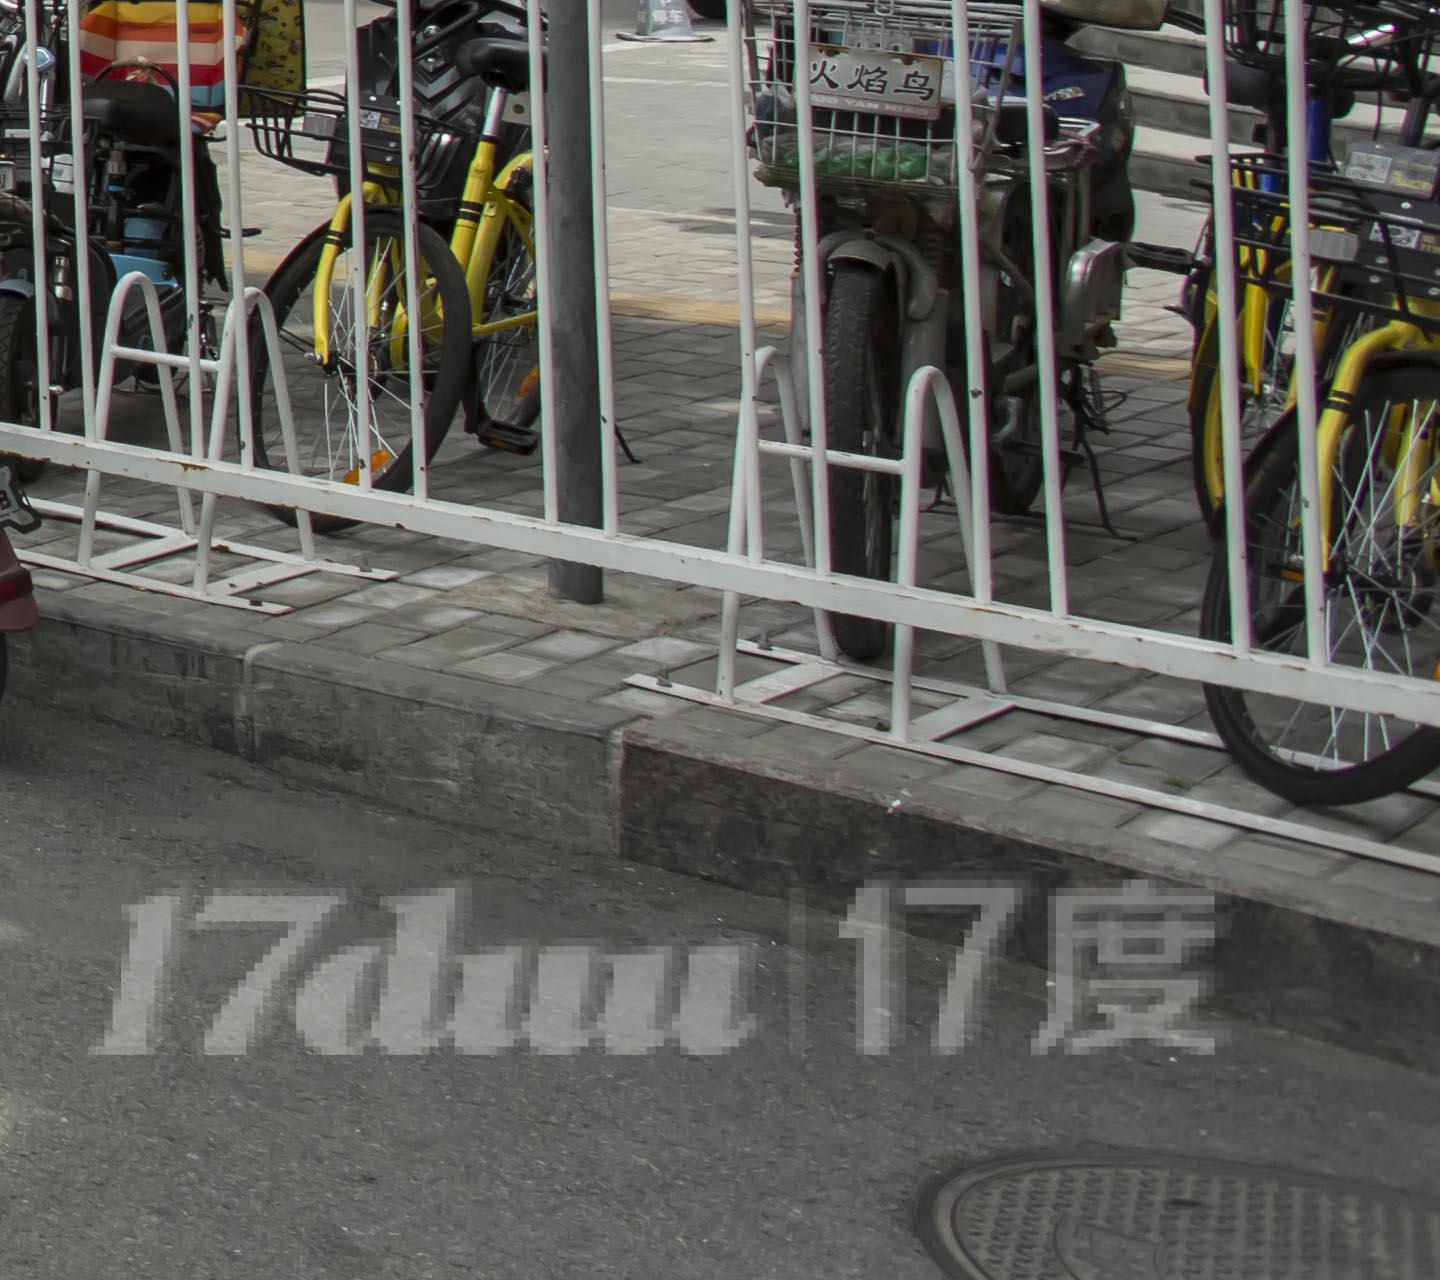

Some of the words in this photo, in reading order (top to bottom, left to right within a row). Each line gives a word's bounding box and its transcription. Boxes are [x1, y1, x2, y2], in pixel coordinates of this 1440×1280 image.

[650, 7, 684, 25] 停车
[809, 58, 936, 103] 火焰鸟
